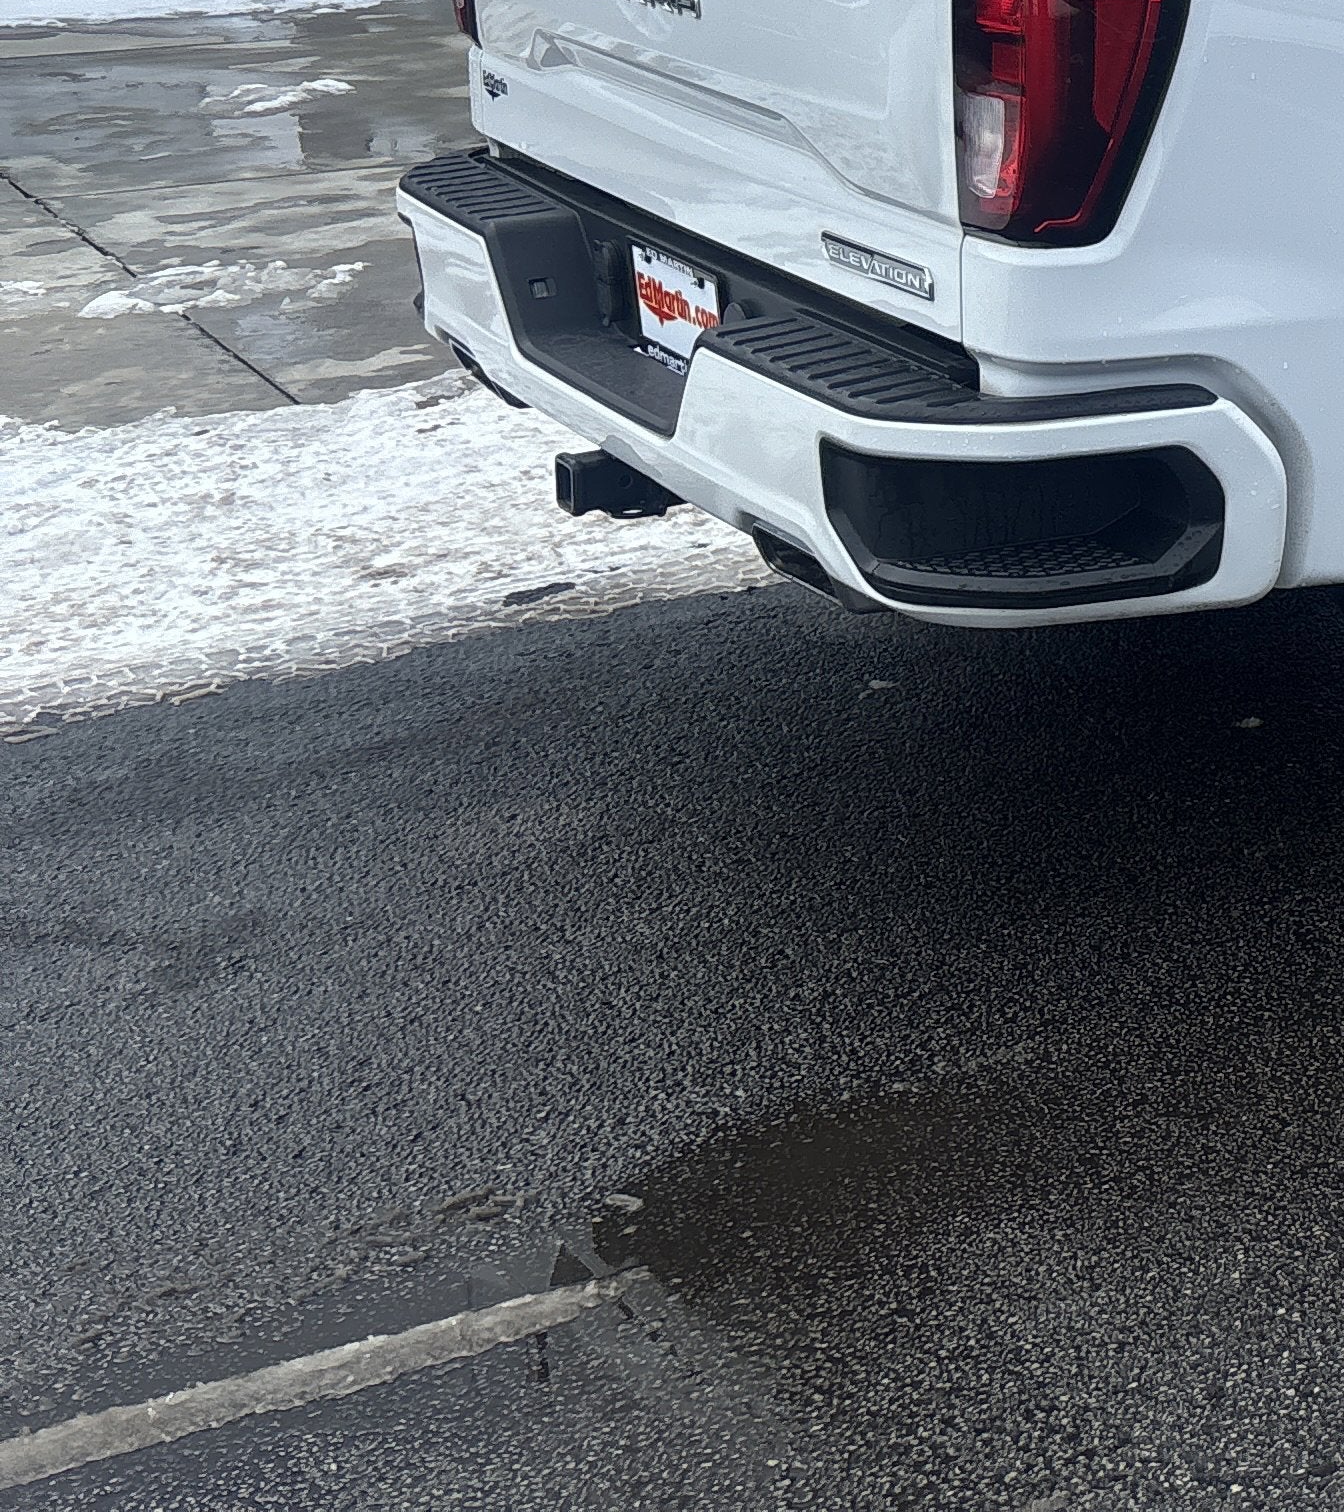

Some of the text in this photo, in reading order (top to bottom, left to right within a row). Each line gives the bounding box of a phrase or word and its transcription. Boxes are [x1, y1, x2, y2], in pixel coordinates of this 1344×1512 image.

[659, 254, 694, 278] MARTIN
[828, 243, 921, 289] ELEVATION
[636, 270, 721, 330] EdMartin.com
